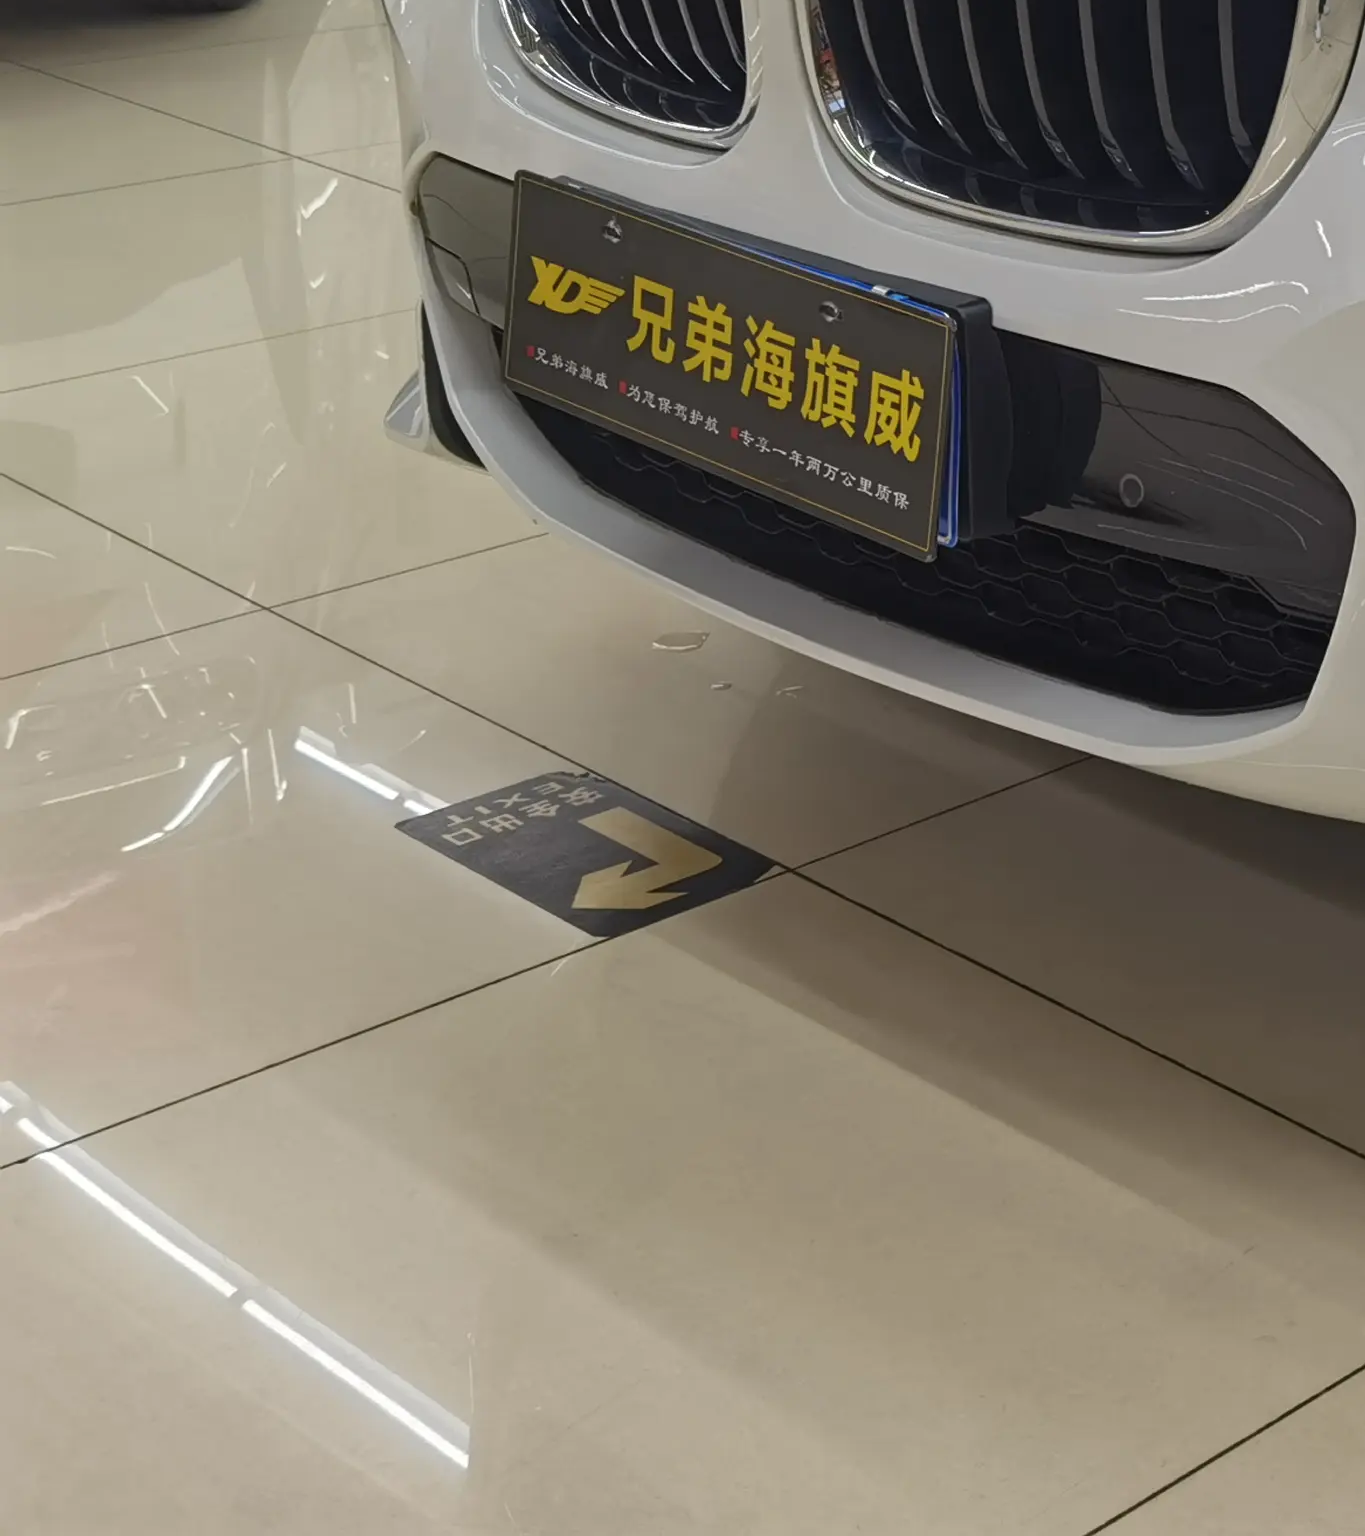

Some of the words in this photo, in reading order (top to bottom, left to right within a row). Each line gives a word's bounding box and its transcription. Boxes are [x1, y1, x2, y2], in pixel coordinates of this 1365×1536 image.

[626, 275, 925, 462] 兄弟海旗威
[535, 347, 609, 390] 兄弟海旗威
[739, 429, 911, 510] 专享一年两万公里质保
[441, 785, 605, 847] 安全出口
[447, 781, 565, 828] EXIT
